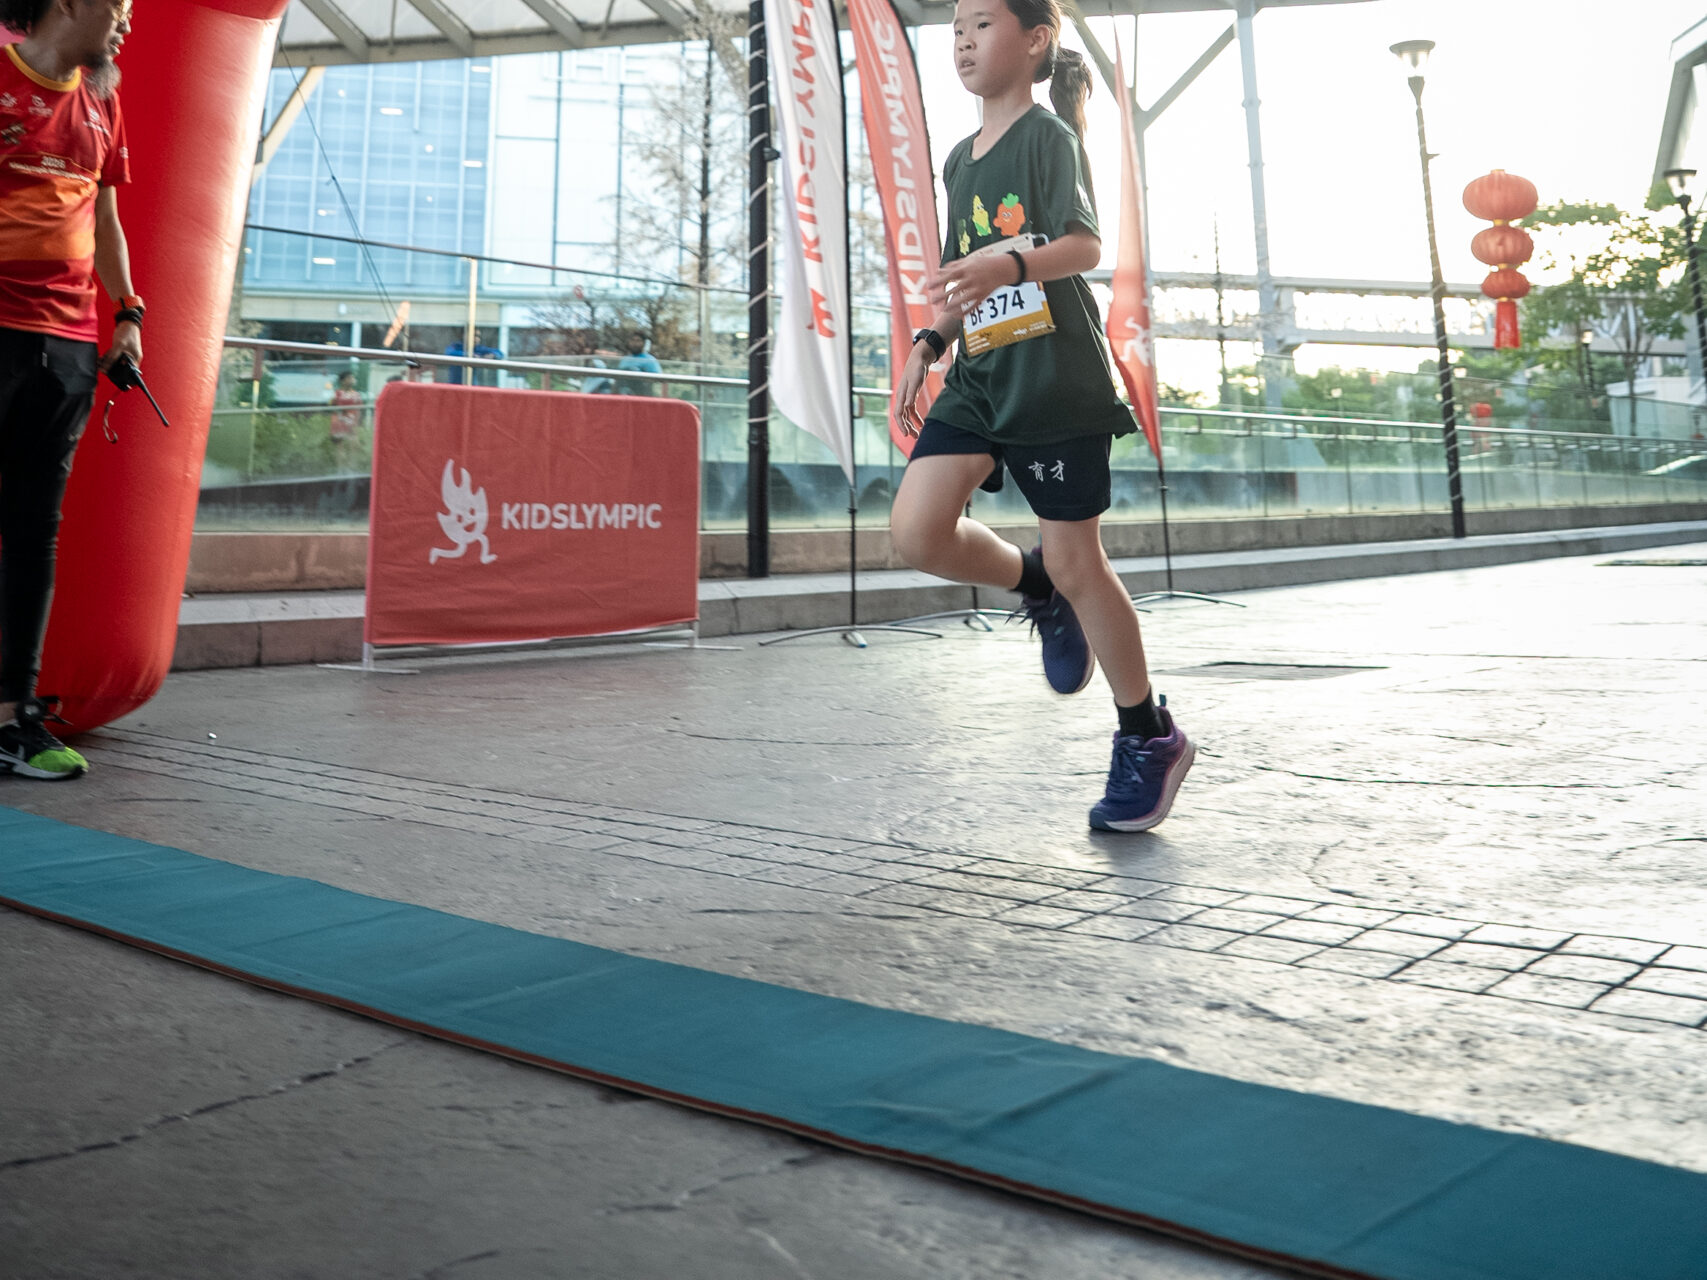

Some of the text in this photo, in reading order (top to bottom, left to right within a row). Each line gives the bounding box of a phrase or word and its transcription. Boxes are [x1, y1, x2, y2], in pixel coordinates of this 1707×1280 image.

[987, 290, 1025, 319] 374
[1028, 460, 1065, 481] 育才
[502, 502, 662, 530] KIDSLYMPIC
